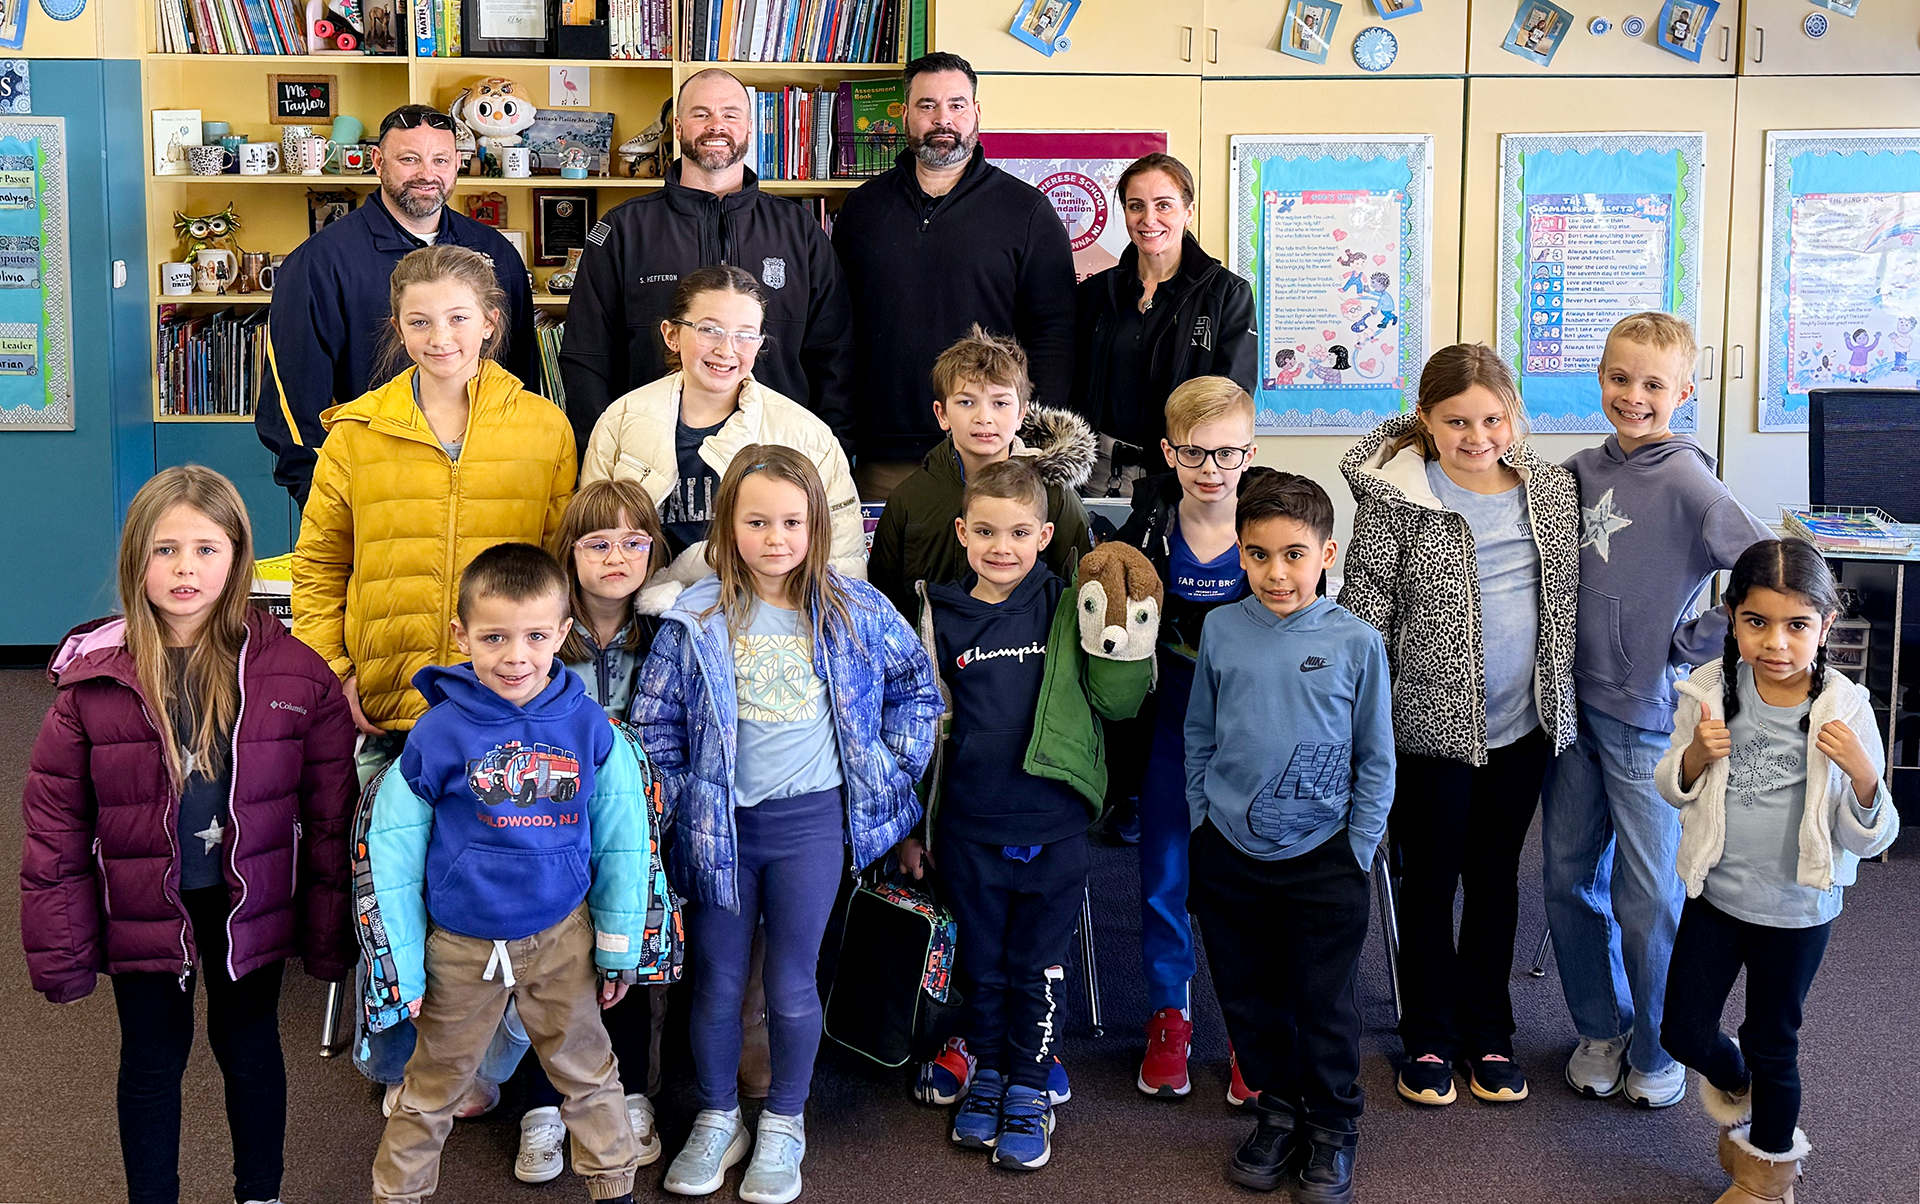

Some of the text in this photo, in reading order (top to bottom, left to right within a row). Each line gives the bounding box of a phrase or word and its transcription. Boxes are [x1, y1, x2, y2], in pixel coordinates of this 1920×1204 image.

[285, 84, 307, 98] Ms.
[855, 86, 896, 94] Assessment
[281, 98, 326, 114] Taylor
[1038, 174, 1105, 212] HERESE SCHOOL
[1058, 198, 1088, 206] family.
[0, 270, 25, 282] livia
[647, 274, 678, 282] HEFFERON
[2, 341, 33, 350] Leader
[1178, 577, 1194, 586] FAR
[1305, 656, 1327, 666] NIKE
[279, 701, 307, 715] Columbia
[560, 813, 578, 825] NJ
